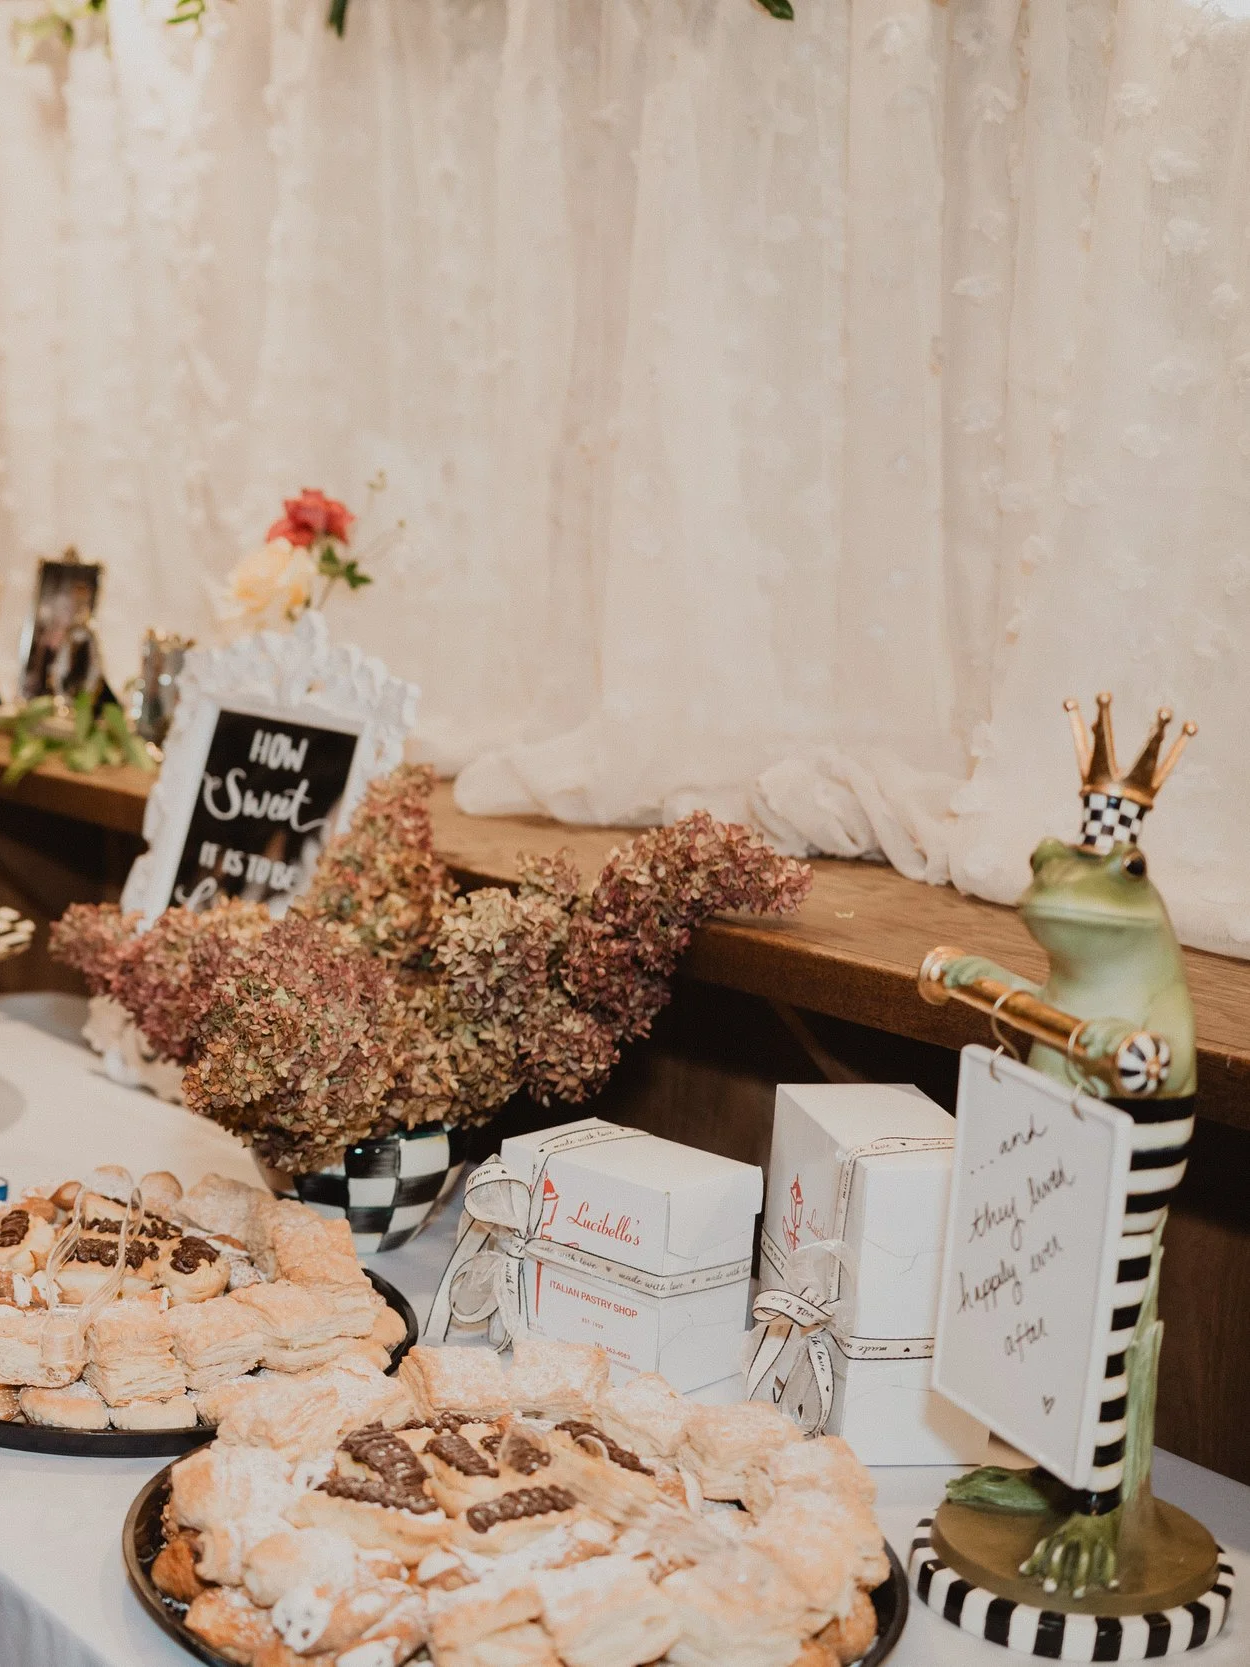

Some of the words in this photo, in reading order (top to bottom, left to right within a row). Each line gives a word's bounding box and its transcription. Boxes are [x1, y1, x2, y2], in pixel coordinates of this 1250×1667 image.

[249, 729, 309, 773] HOW
[198, 841, 221, 869] IT
[221, 848, 245, 877] IS
[246, 854, 271, 885] TO
[578, 1132, 595, 1143] with
[968, 1197, 1026, 1251] they
[1026, 1156, 1077, 1214] lived
[566, 1201, 640, 1246] Lucibello's
[579, 1256, 597, 1270] love
[618, 1272, 642, 1285] made
[645, 1282, 666, 1292] with
[670, 1281, 684, 1291] love
[957, 1259, 1022, 1313] happily
[1030, 1235, 1062, 1273] ever
[550, 1280, 580, 1298] ITALIAN
[581, 1292, 612, 1310] PASTRY
[613, 1303, 638, 1319] SHOP
[770, 1295, 793, 1309] love
[796, 1304, 815, 1319] with
[858, 1345, 888, 1355] made
[1005, 1317, 1048, 1361] after
[817, 1351, 827, 1374] love
